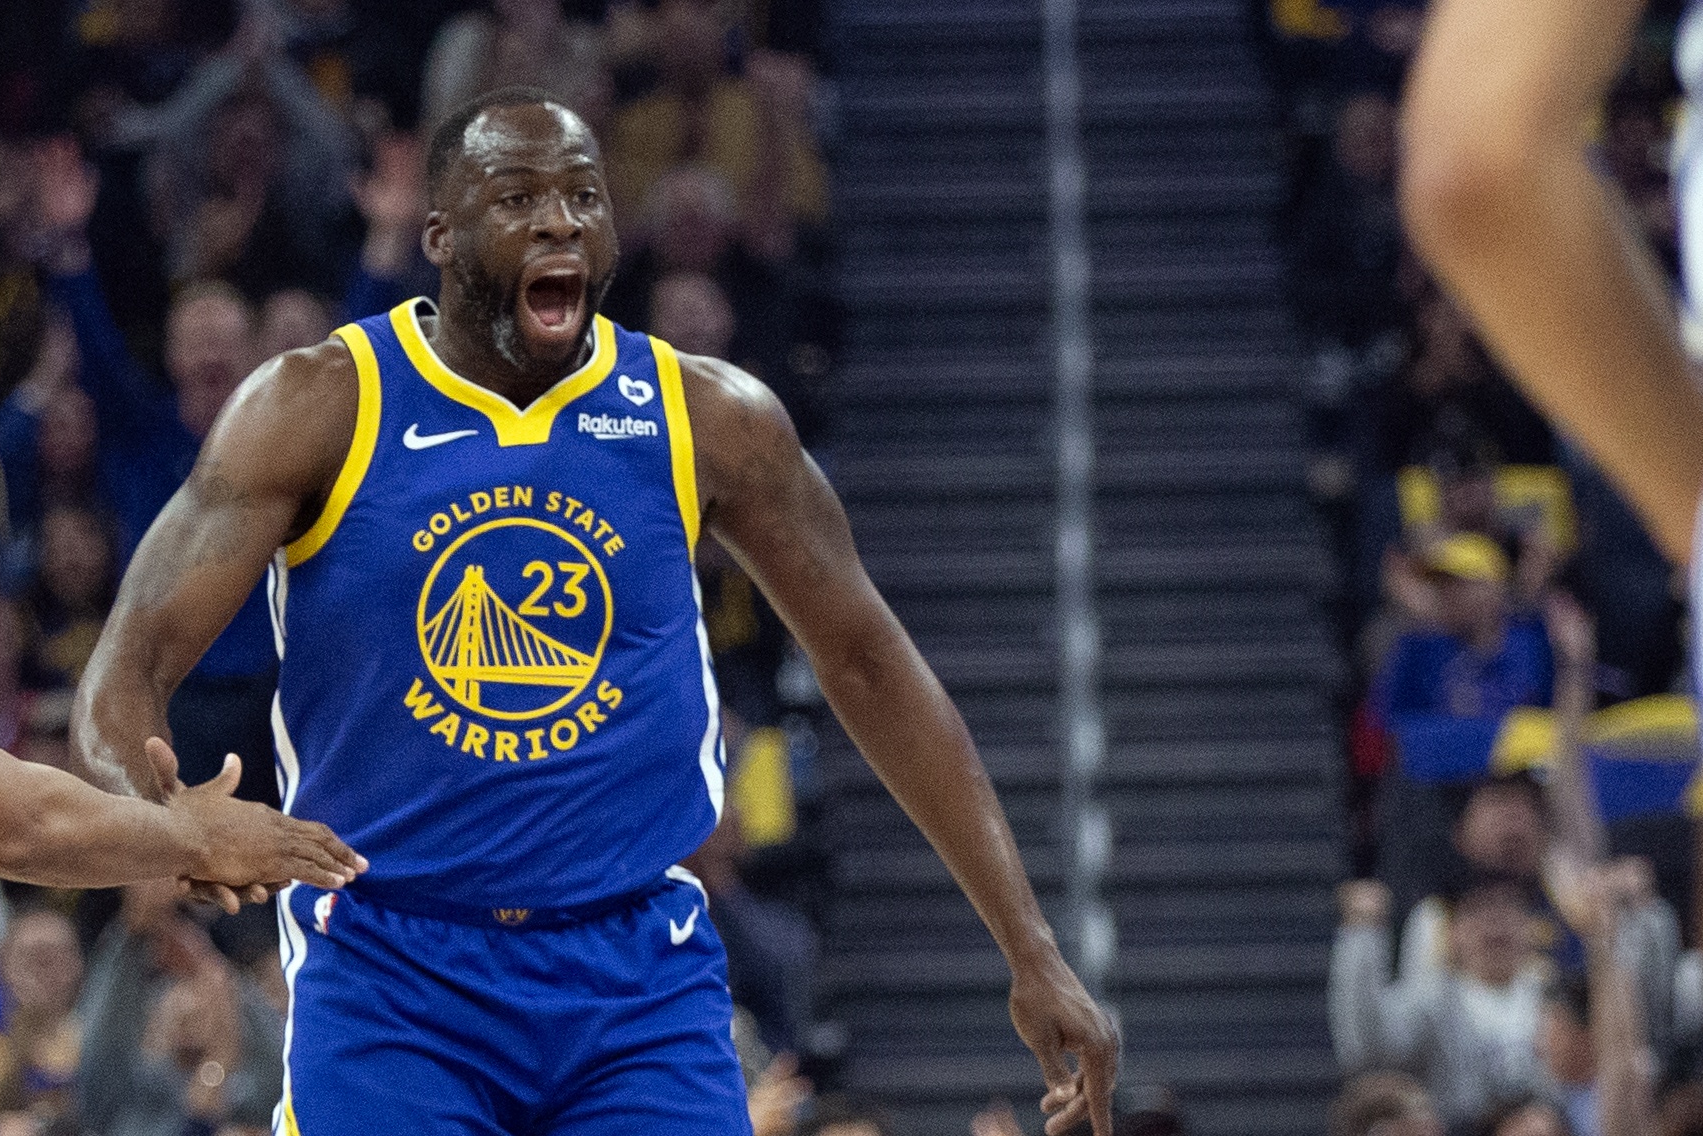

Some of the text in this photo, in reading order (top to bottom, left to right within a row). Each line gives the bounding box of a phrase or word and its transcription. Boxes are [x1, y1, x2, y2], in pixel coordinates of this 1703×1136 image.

[578, 413, 658, 437] Rakuten
[412, 486, 625, 557] GOLDEN STATE
[518, 561, 590, 618] 23
[403, 678, 623, 762] WARRIORS
